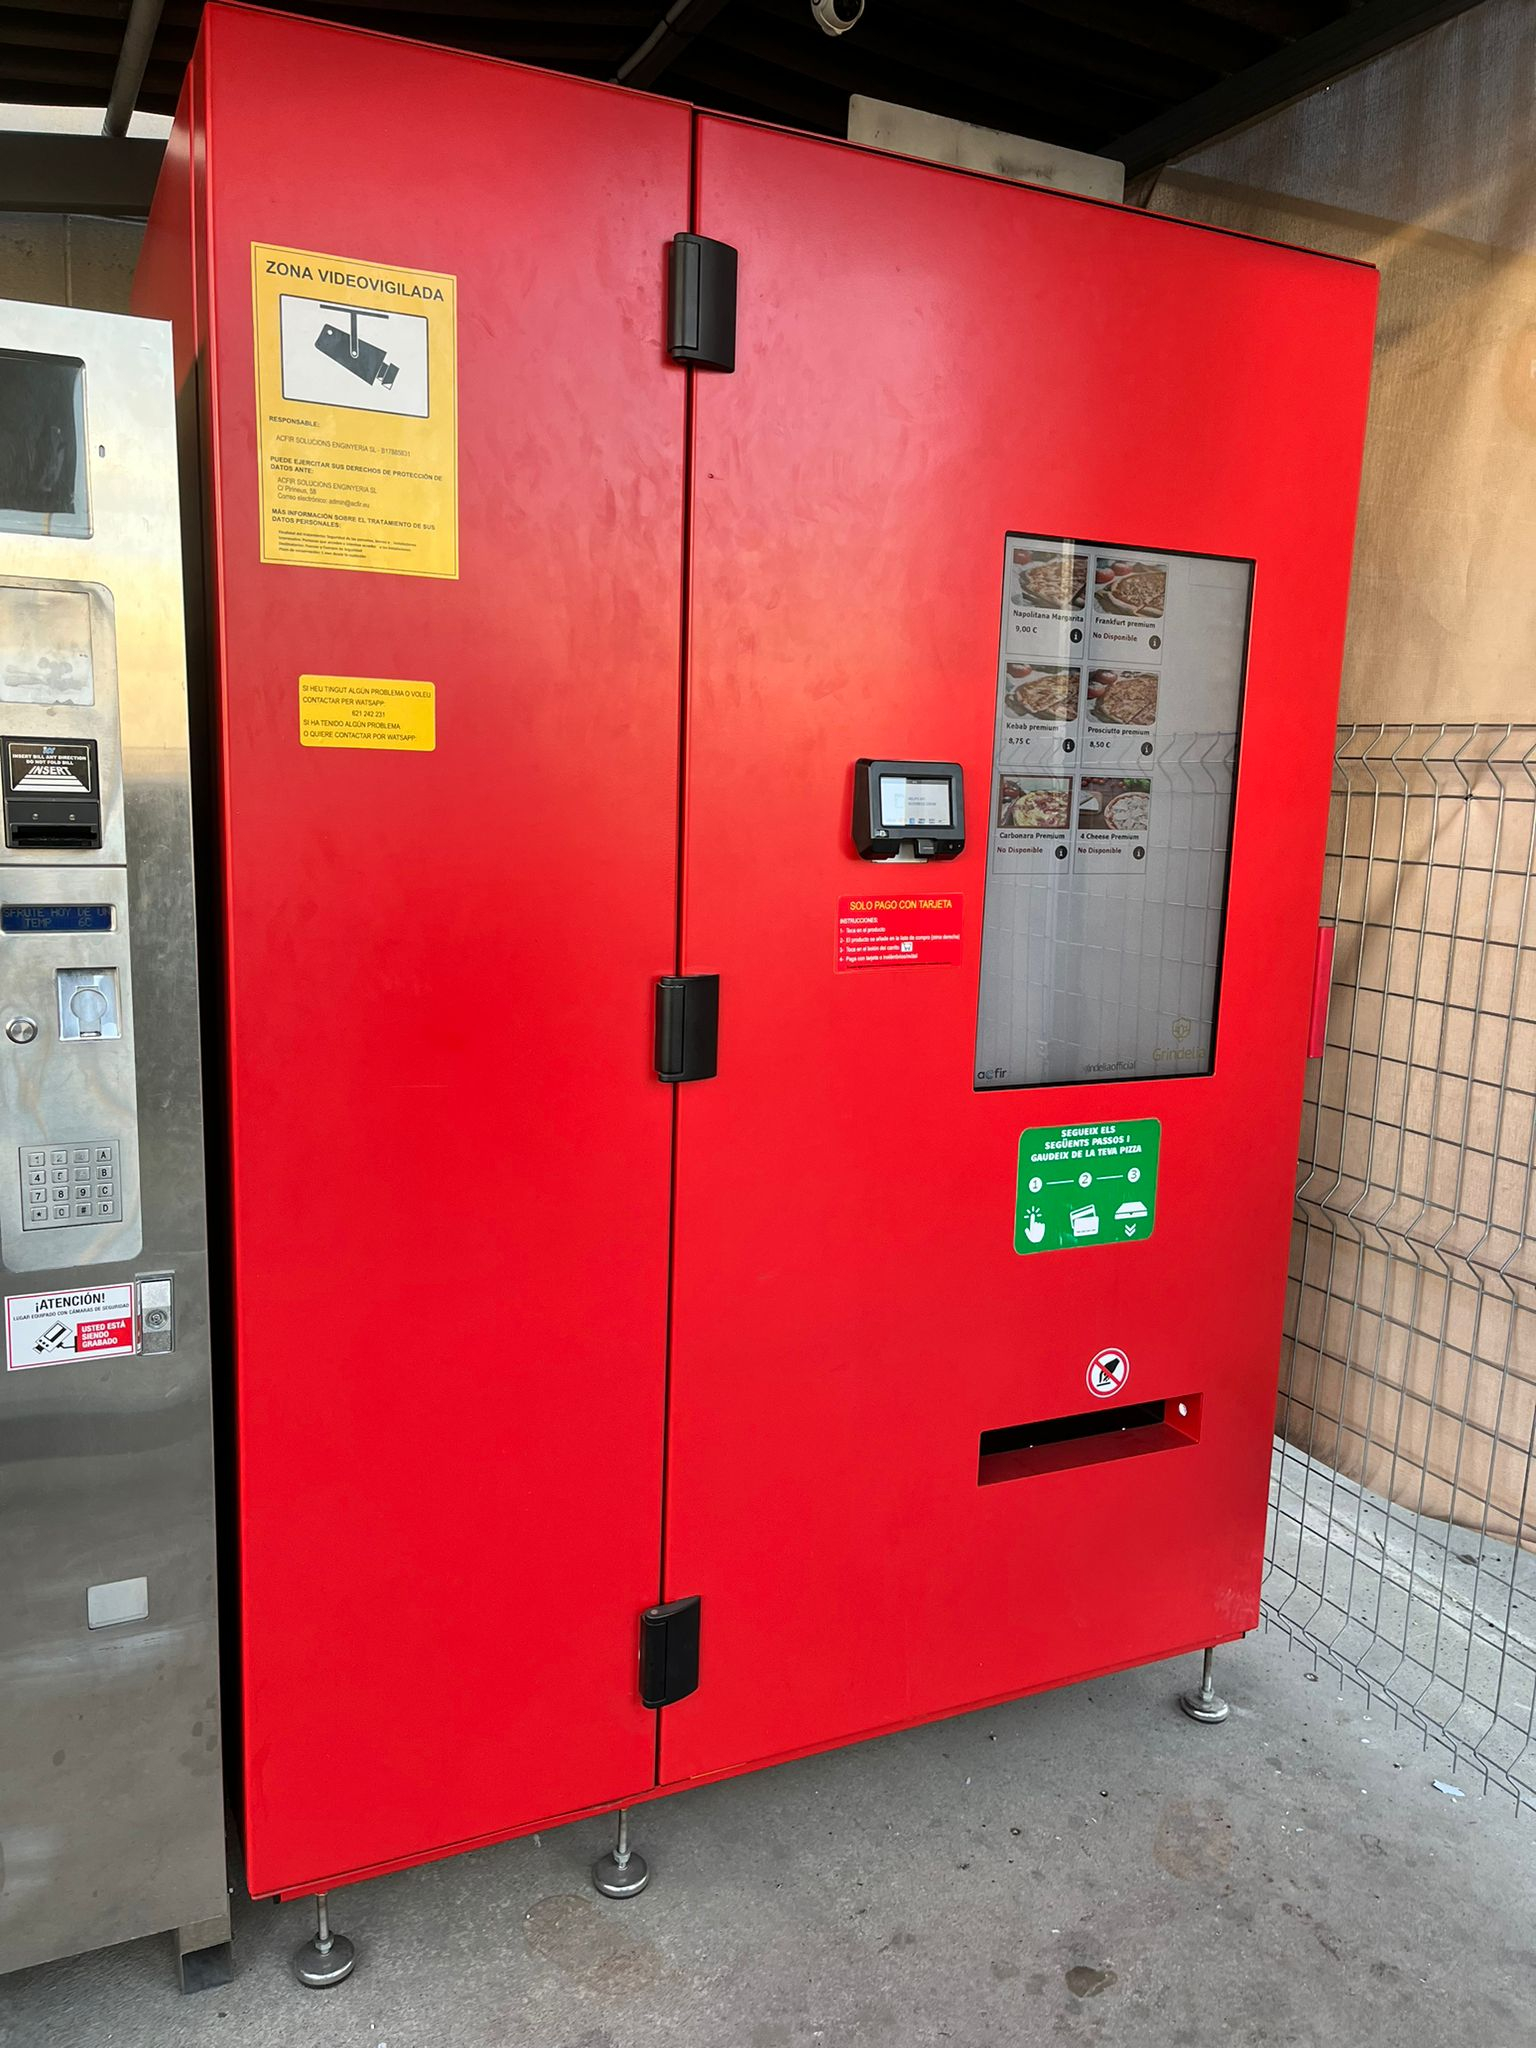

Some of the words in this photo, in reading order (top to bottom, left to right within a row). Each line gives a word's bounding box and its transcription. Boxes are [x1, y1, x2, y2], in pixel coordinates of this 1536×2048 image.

[265, 260, 313, 280] ZONA
[318, 269, 444, 301] VIDEOVIGILADA
[269, 416, 320, 427] RESPONSABLE:
[270, 456, 292, 464] PUEDE
[294, 458, 330, 468] EJERCITAR
[331, 462, 344, 470] SUS
[346, 465, 381, 475] DERECHOS
[392, 470, 433, 480] PROTECCIÓN
[270, 464, 293, 472] DATOS
[294, 466, 314, 474] ANTE:
[277, 493, 296, 501] Correo
[272, 516, 294, 524] DATOS
[296, 518, 341, 528] PERSONALES:
[287, 510, 333, 520] INFORMACIÓN
[334, 515, 357, 523] SOBRE
[368, 518, 412, 528] TRATAMIENTO
[1013, 610, 1050, 620] Napolitana
[1051, 613, 1084, 624] Margarita
[1095, 617, 1125, 627] Frankfurt
[1127, 620, 1156, 629] premium
[1015, 625, 1031, 634] 9,00
[1032, 626, 1038, 634] €
[1103, 633, 1137, 642] Disponible
[310, 685, 323, 693] HEU
[324, 686, 347, 694] TINGUT
[371, 688, 404, 697] PROBLEMA
[303, 696, 340, 704] CONTACTAR
[367, 721, 401, 730] PROBLEMA
[1006, 722, 1028, 730] Kebab
[1029, 723, 1059, 732] premium
[1088, 726, 1120, 734] Prosciutto
[309, 731, 333, 739] QUIERE
[1008, 737, 1024, 745] 8,75
[1106, 741, 1111, 749] €
[28, 765, 72, 776] INSERT
[999, 832, 1034, 840] Carbonara
[1035, 832, 1065, 840] Premium
[1008, 846, 1043, 855] Disponible
[1088, 847, 1122, 855] Disponible
[850, 901, 873, 911] SOLO
[874, 900, 897, 910] PAGO
[898, 900, 917, 909] CON
[918, 899, 952, 909] TARJETA
[50, 908, 72, 917] HOY
[77, 908, 92, 917] DE
[25, 918, 52, 928] TEMP
[1152, 1047, 1205, 1061] Grindelia
[1061, 1127, 1098, 1137] SEGUEIX
[1100, 1125, 1116, 1135] ELS
[1044, 1138, 1089, 1150] SEGÜENTS
[1092, 1136, 1124, 1146] PASSOS
[1127, 1135, 1130, 1143] I
[100, 1151, 106, 1159] A
[1031, 1152, 1068, 1162] GAUDEIX
[1071, 1150, 1083, 1159] DE
[1085, 1149, 1095, 1157] LA
[1098, 1147, 1117, 1156] TEVA
[1120, 1145, 1142, 1154] PIZZA
[101, 1168, 107, 1176] B
[1033, 1180, 1038, 1189] 1
[1082, 1175, 1088, 1184] 2
[1131, 1170, 1137, 1179] 3
[58, 1190, 64, 1198] 8
[80, 1188, 86, 1196] 9
[102, 1186, 108, 1194] C
[102, 1204, 108, 1212] D
[36, 1292, 105, 1313] ¡ATENCIÓN!
[31, 1311, 56, 1320] EQUIPADO
[69, 1307, 93, 1315] CÁMARAS
[102, 1303, 129, 1311] SEGURIDAD
[82, 1323, 105, 1333] USTED
[107, 1321, 126, 1331] ESTÁ
[82, 1331, 109, 1340] SIENDO
[82, 1338, 118, 1348] GRABADO
